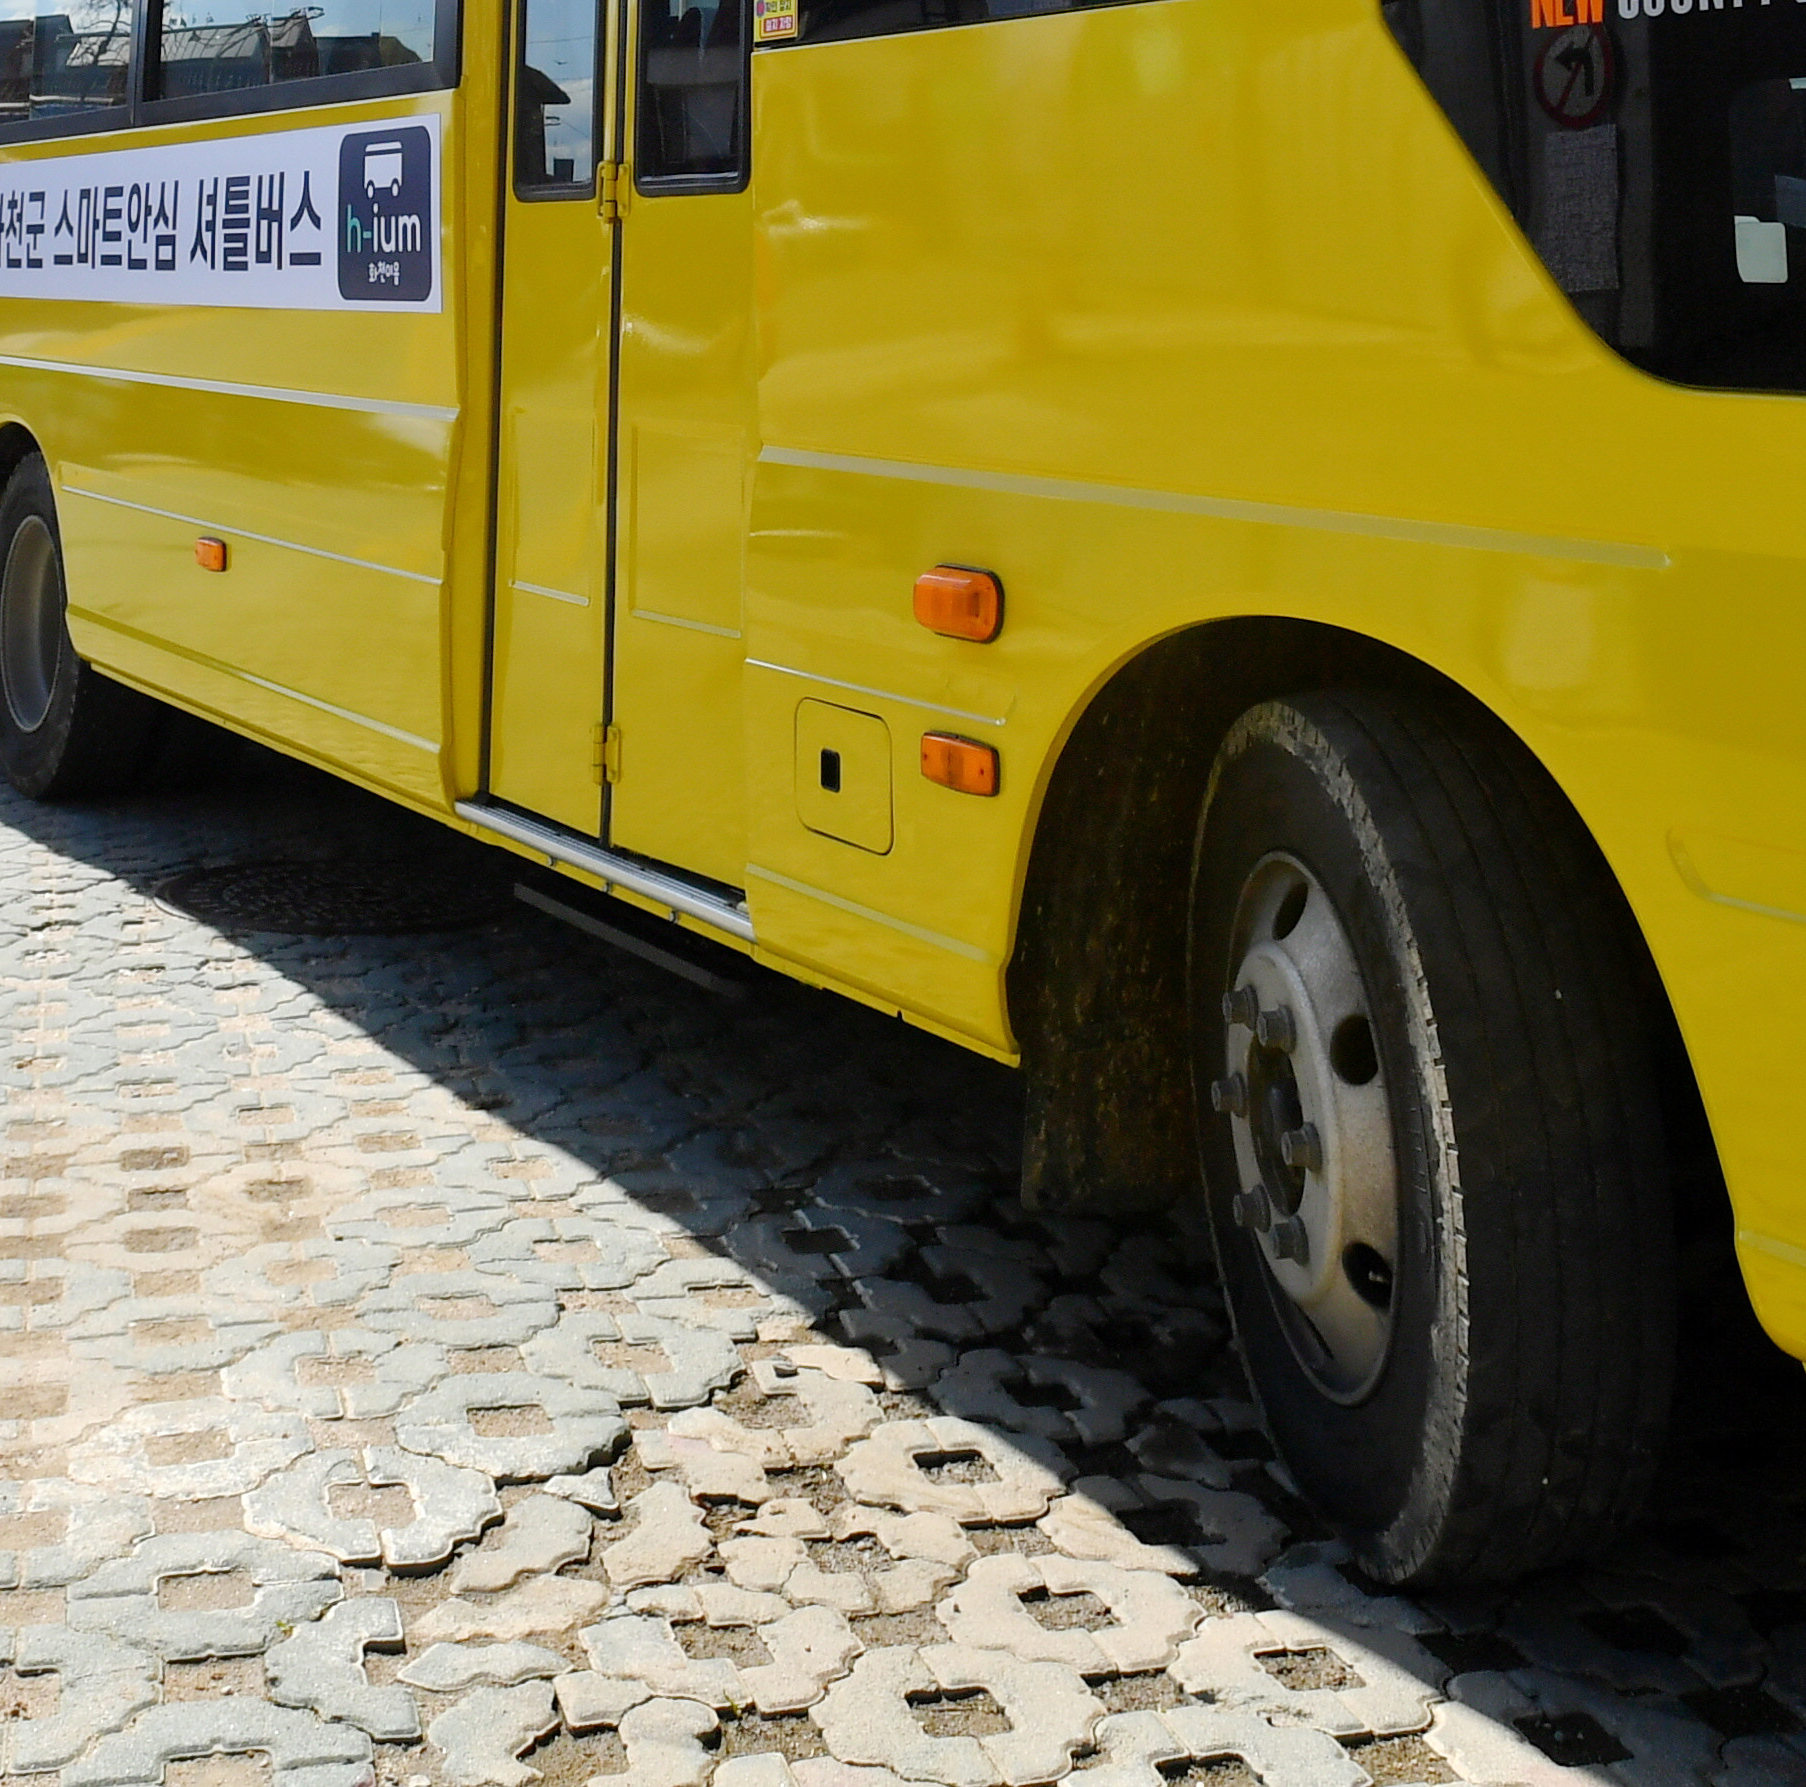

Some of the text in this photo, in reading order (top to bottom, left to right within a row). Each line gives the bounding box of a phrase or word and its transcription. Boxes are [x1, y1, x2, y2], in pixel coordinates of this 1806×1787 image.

[53, 179, 180, 272] 스마트안심
[189, 170, 322, 272] 셔틀버스
[347, 202, 421, 253] h-ium
[368, 260, 400, 286] 화천이음
